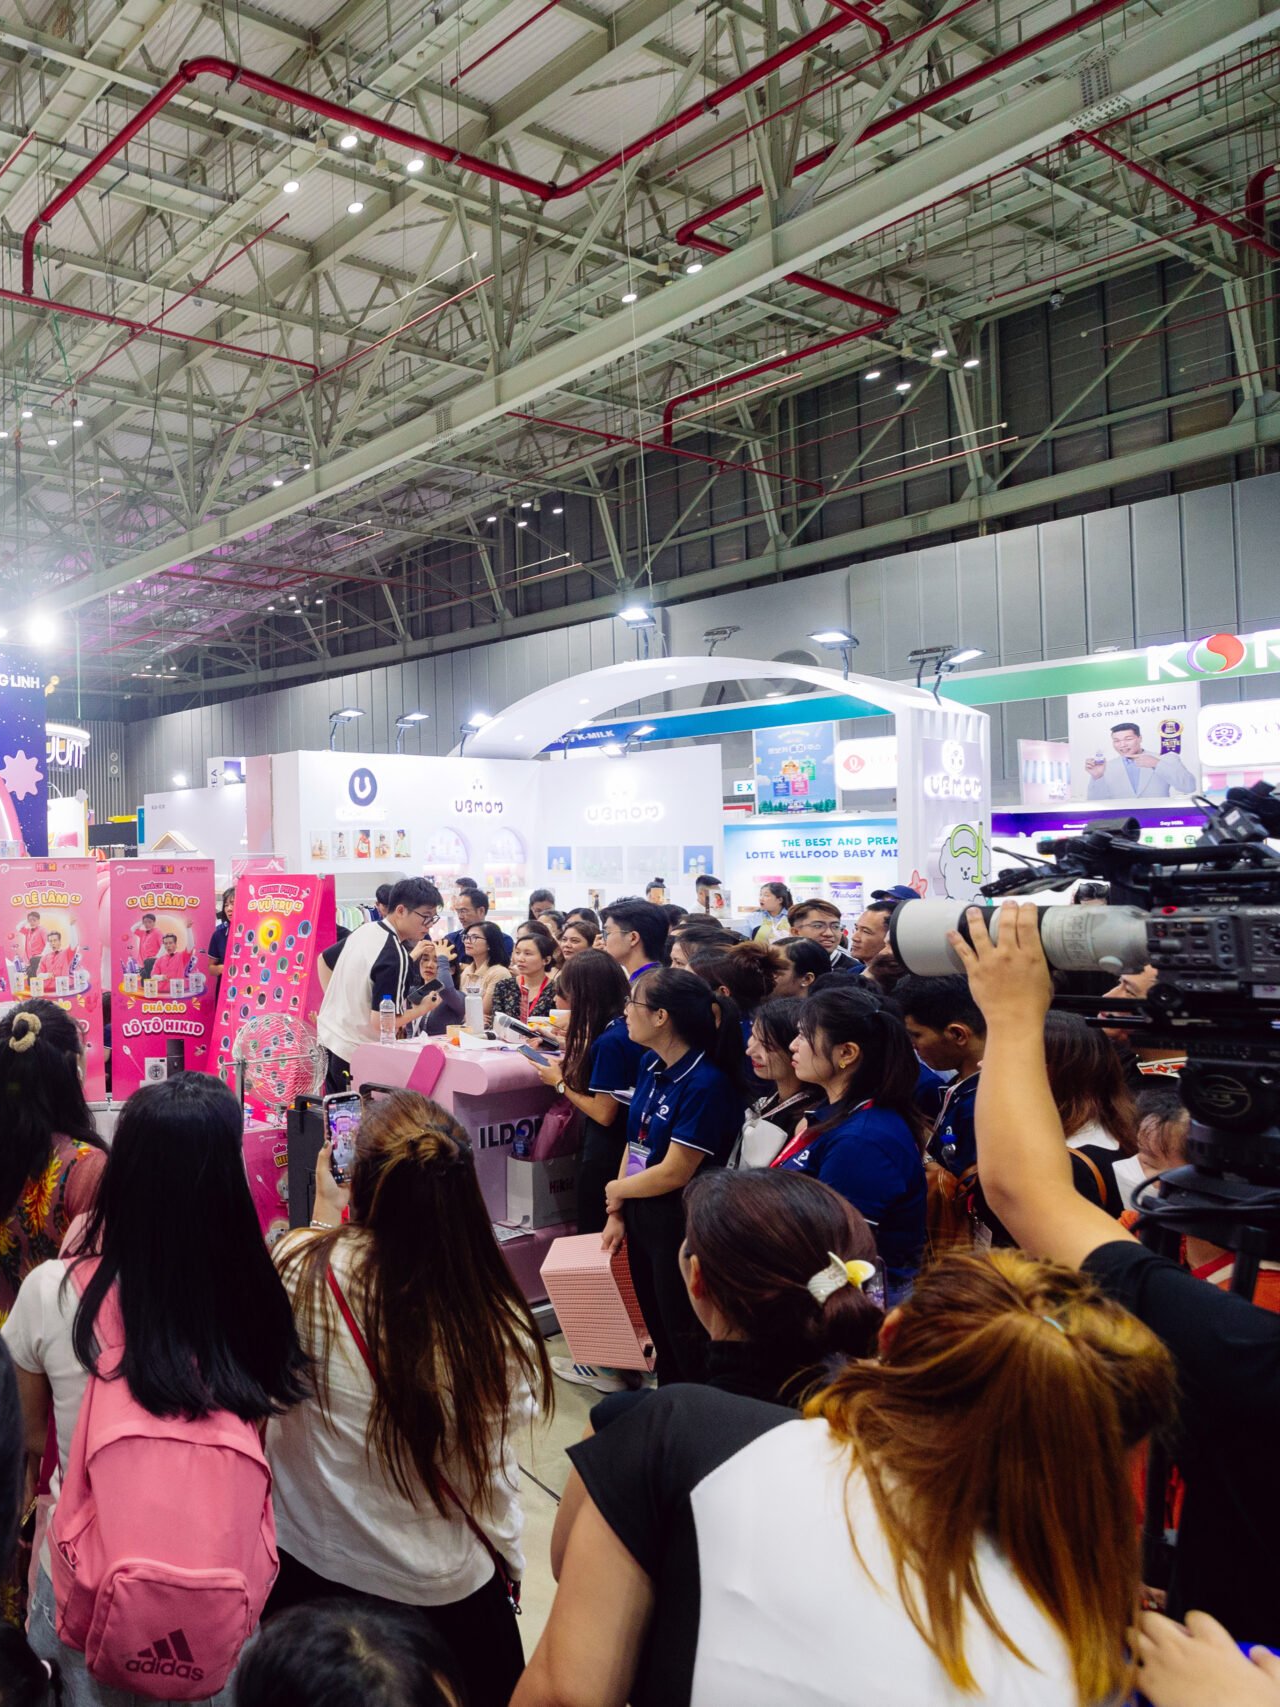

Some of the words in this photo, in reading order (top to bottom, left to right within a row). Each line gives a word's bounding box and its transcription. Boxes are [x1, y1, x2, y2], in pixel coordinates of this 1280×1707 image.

[10, 674, 40, 689] LINH
[1163, 703, 1187, 711] Nam
[737, 783, 753, 792] EX
[782, 838, 801, 847] THE
[805, 837, 832, 847] BEST
[838, 837, 862, 846] AND
[867, 835, 898, 846] PREM
[746, 850, 776, 860] LOTTE
[779, 849, 839, 860] WELLFOOD
[843, 849, 876, 859] BABY
[880, 848, 898, 858] MI
[140, 893, 155, 907] LÊ
[157, 892, 186, 908] LÂM
[142, 1001, 163, 1013] PHÁ
[123, 1019, 141, 1036] LÔ
[142, 1017, 162, 1033] TÔ
[164, 1020, 204, 1036] HIKID
[479, 1117, 544, 1150] ILDO
[125, 1656, 205, 1682] adidas
